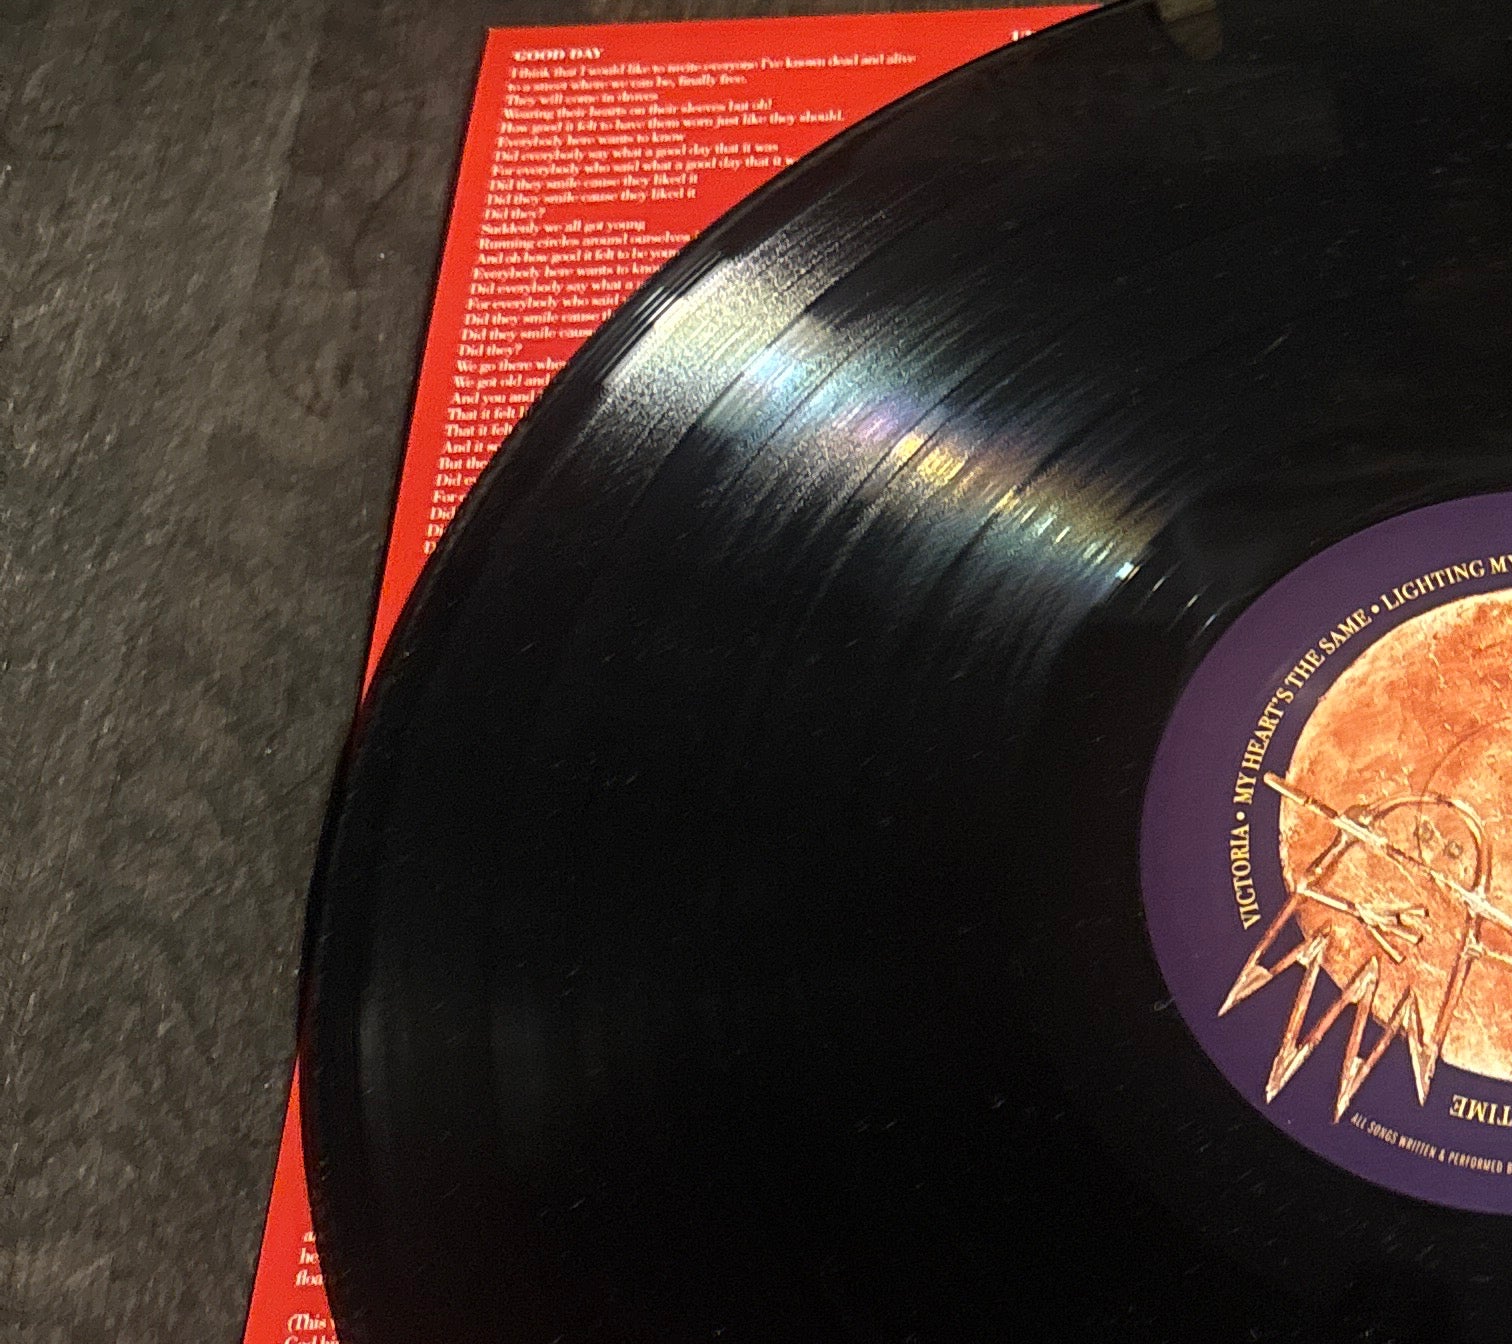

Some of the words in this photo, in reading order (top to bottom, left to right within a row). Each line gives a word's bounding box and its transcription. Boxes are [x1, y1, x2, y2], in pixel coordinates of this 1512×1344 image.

[513, 48, 566, 60] GOOD
[569, 47, 603, 58] DAY
[1380, 559, 1485, 610] LIGHTING
[1318, 608, 1372, 655] SAME
[1284, 648, 1325, 690] THE
[1241, 687, 1294, 772] HEART'S
[1234, 774, 1257, 805] MY
[1229, 818, 1260, 929] VICTORIA
[1350, 1112, 1365, 1130] ALL
[1367, 1120, 1399, 1145] SONGS
[1399, 1135, 1436, 1159] WRITTEN
[1448, 1151, 1503, 1173] PERFORMED
[287, 1312, 326, 1331] (This
